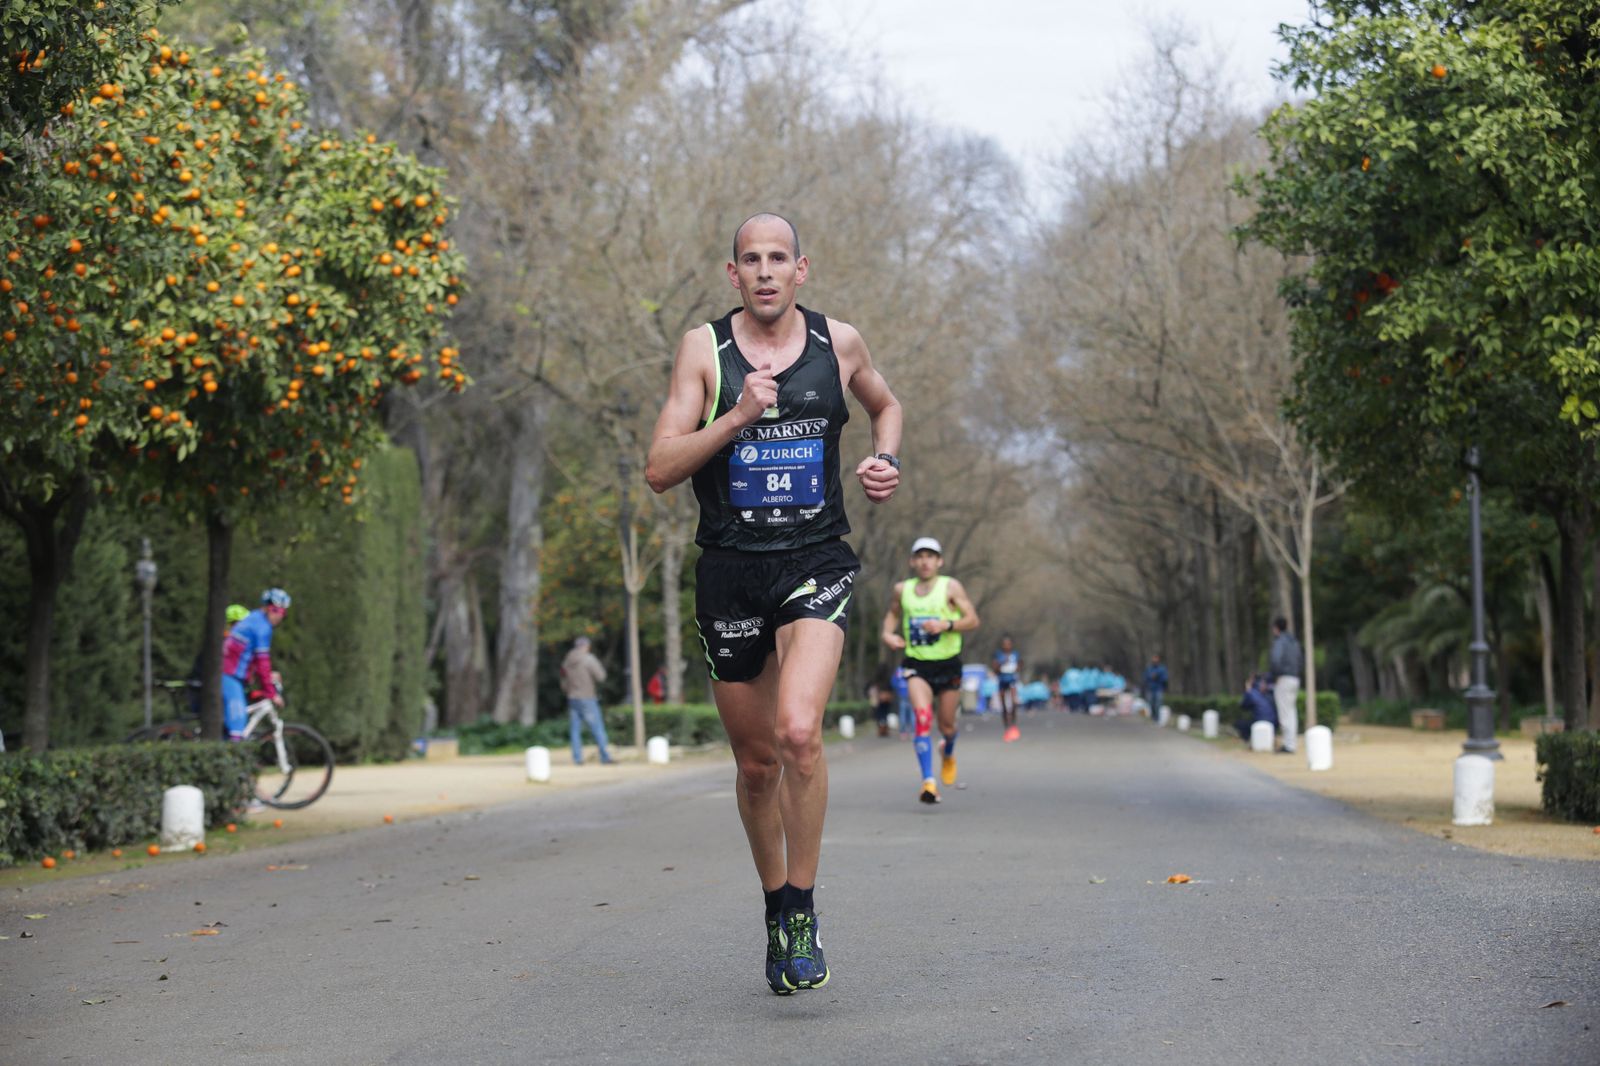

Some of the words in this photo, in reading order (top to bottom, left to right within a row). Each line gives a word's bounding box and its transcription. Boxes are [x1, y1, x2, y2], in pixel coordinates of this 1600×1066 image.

[761, 447, 813, 460] ZURICH
[766, 472, 792, 491] 84
[762, 495, 793, 503] ALBERTO
